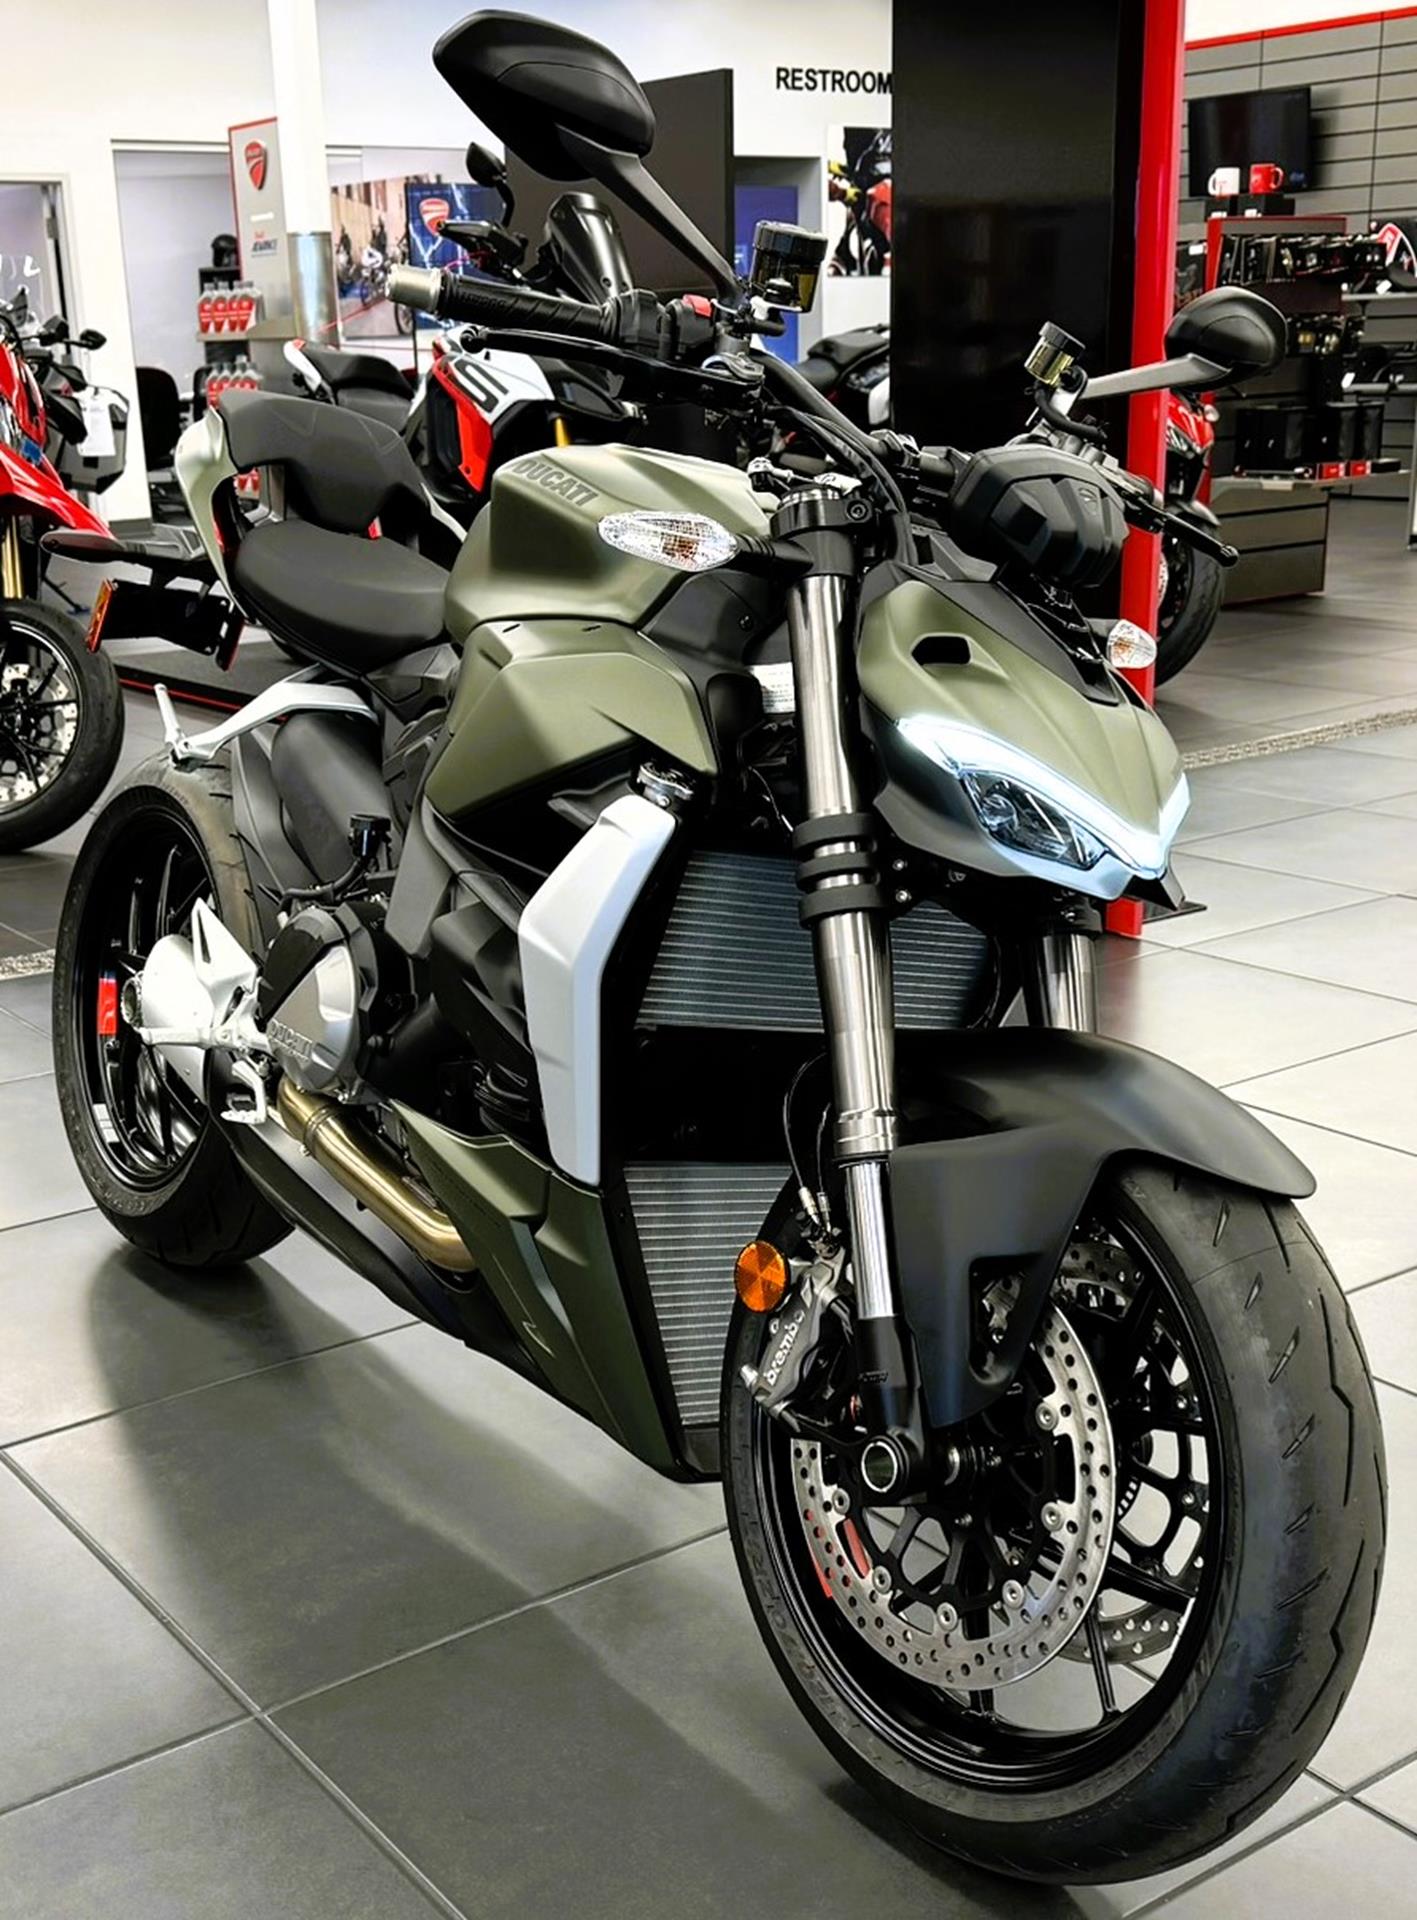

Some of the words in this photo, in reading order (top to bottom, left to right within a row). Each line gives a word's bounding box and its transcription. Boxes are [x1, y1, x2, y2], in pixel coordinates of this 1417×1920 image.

[776, 66, 894, 94] RESTROOM
[511, 459, 599, 507] DUCATI
[763, 1309, 806, 1386] brembo
